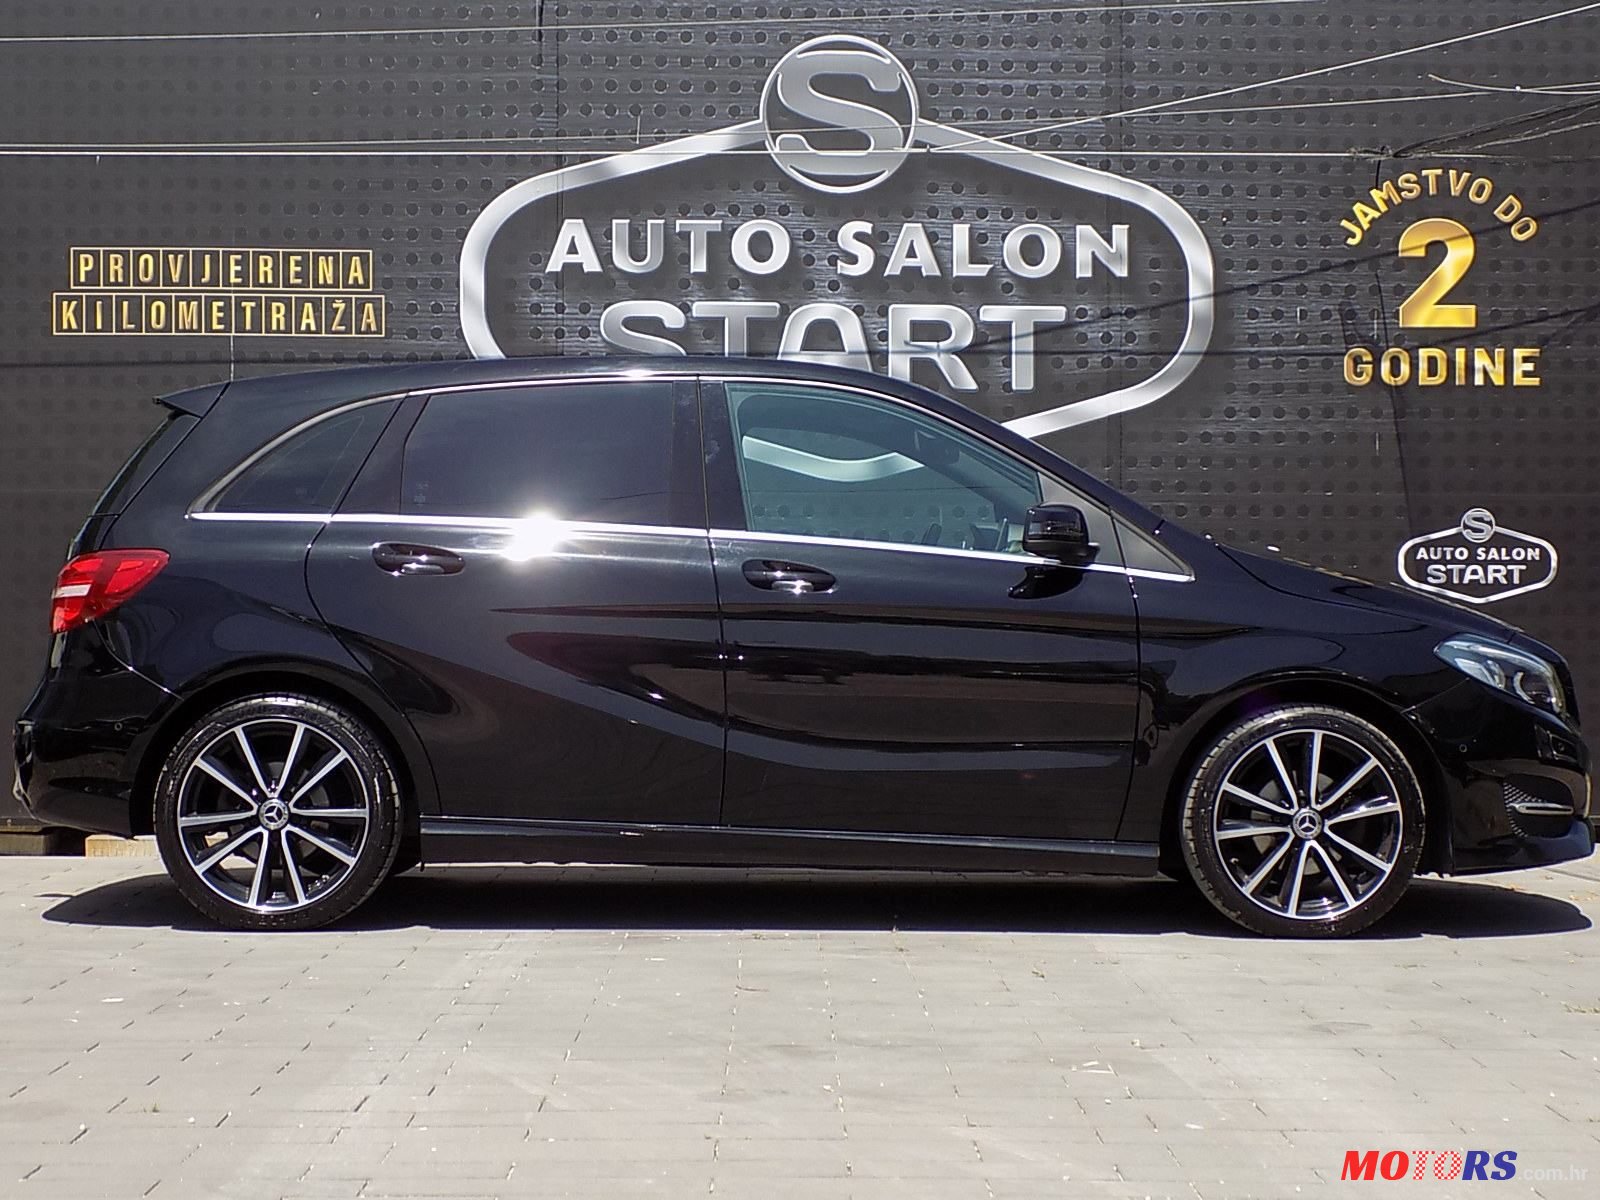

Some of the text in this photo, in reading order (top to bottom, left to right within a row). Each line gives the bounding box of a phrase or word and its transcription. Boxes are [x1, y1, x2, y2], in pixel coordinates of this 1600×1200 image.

[1340, 168, 1538, 246] JAMSTVO DO
[545, 218, 1130, 279] AUTO SALON
[79, 253, 365, 285] PROVJERENA
[1398, 217, 1477, 328] 2
[61, 299, 378, 333] KILOMETRAŽA
[600, 300, 1067, 392] START
[1343, 347, 1541, 386] GODINE
[1416, 547, 1540, 561] AUTO SALON
[1427, 564, 1527, 585] START
